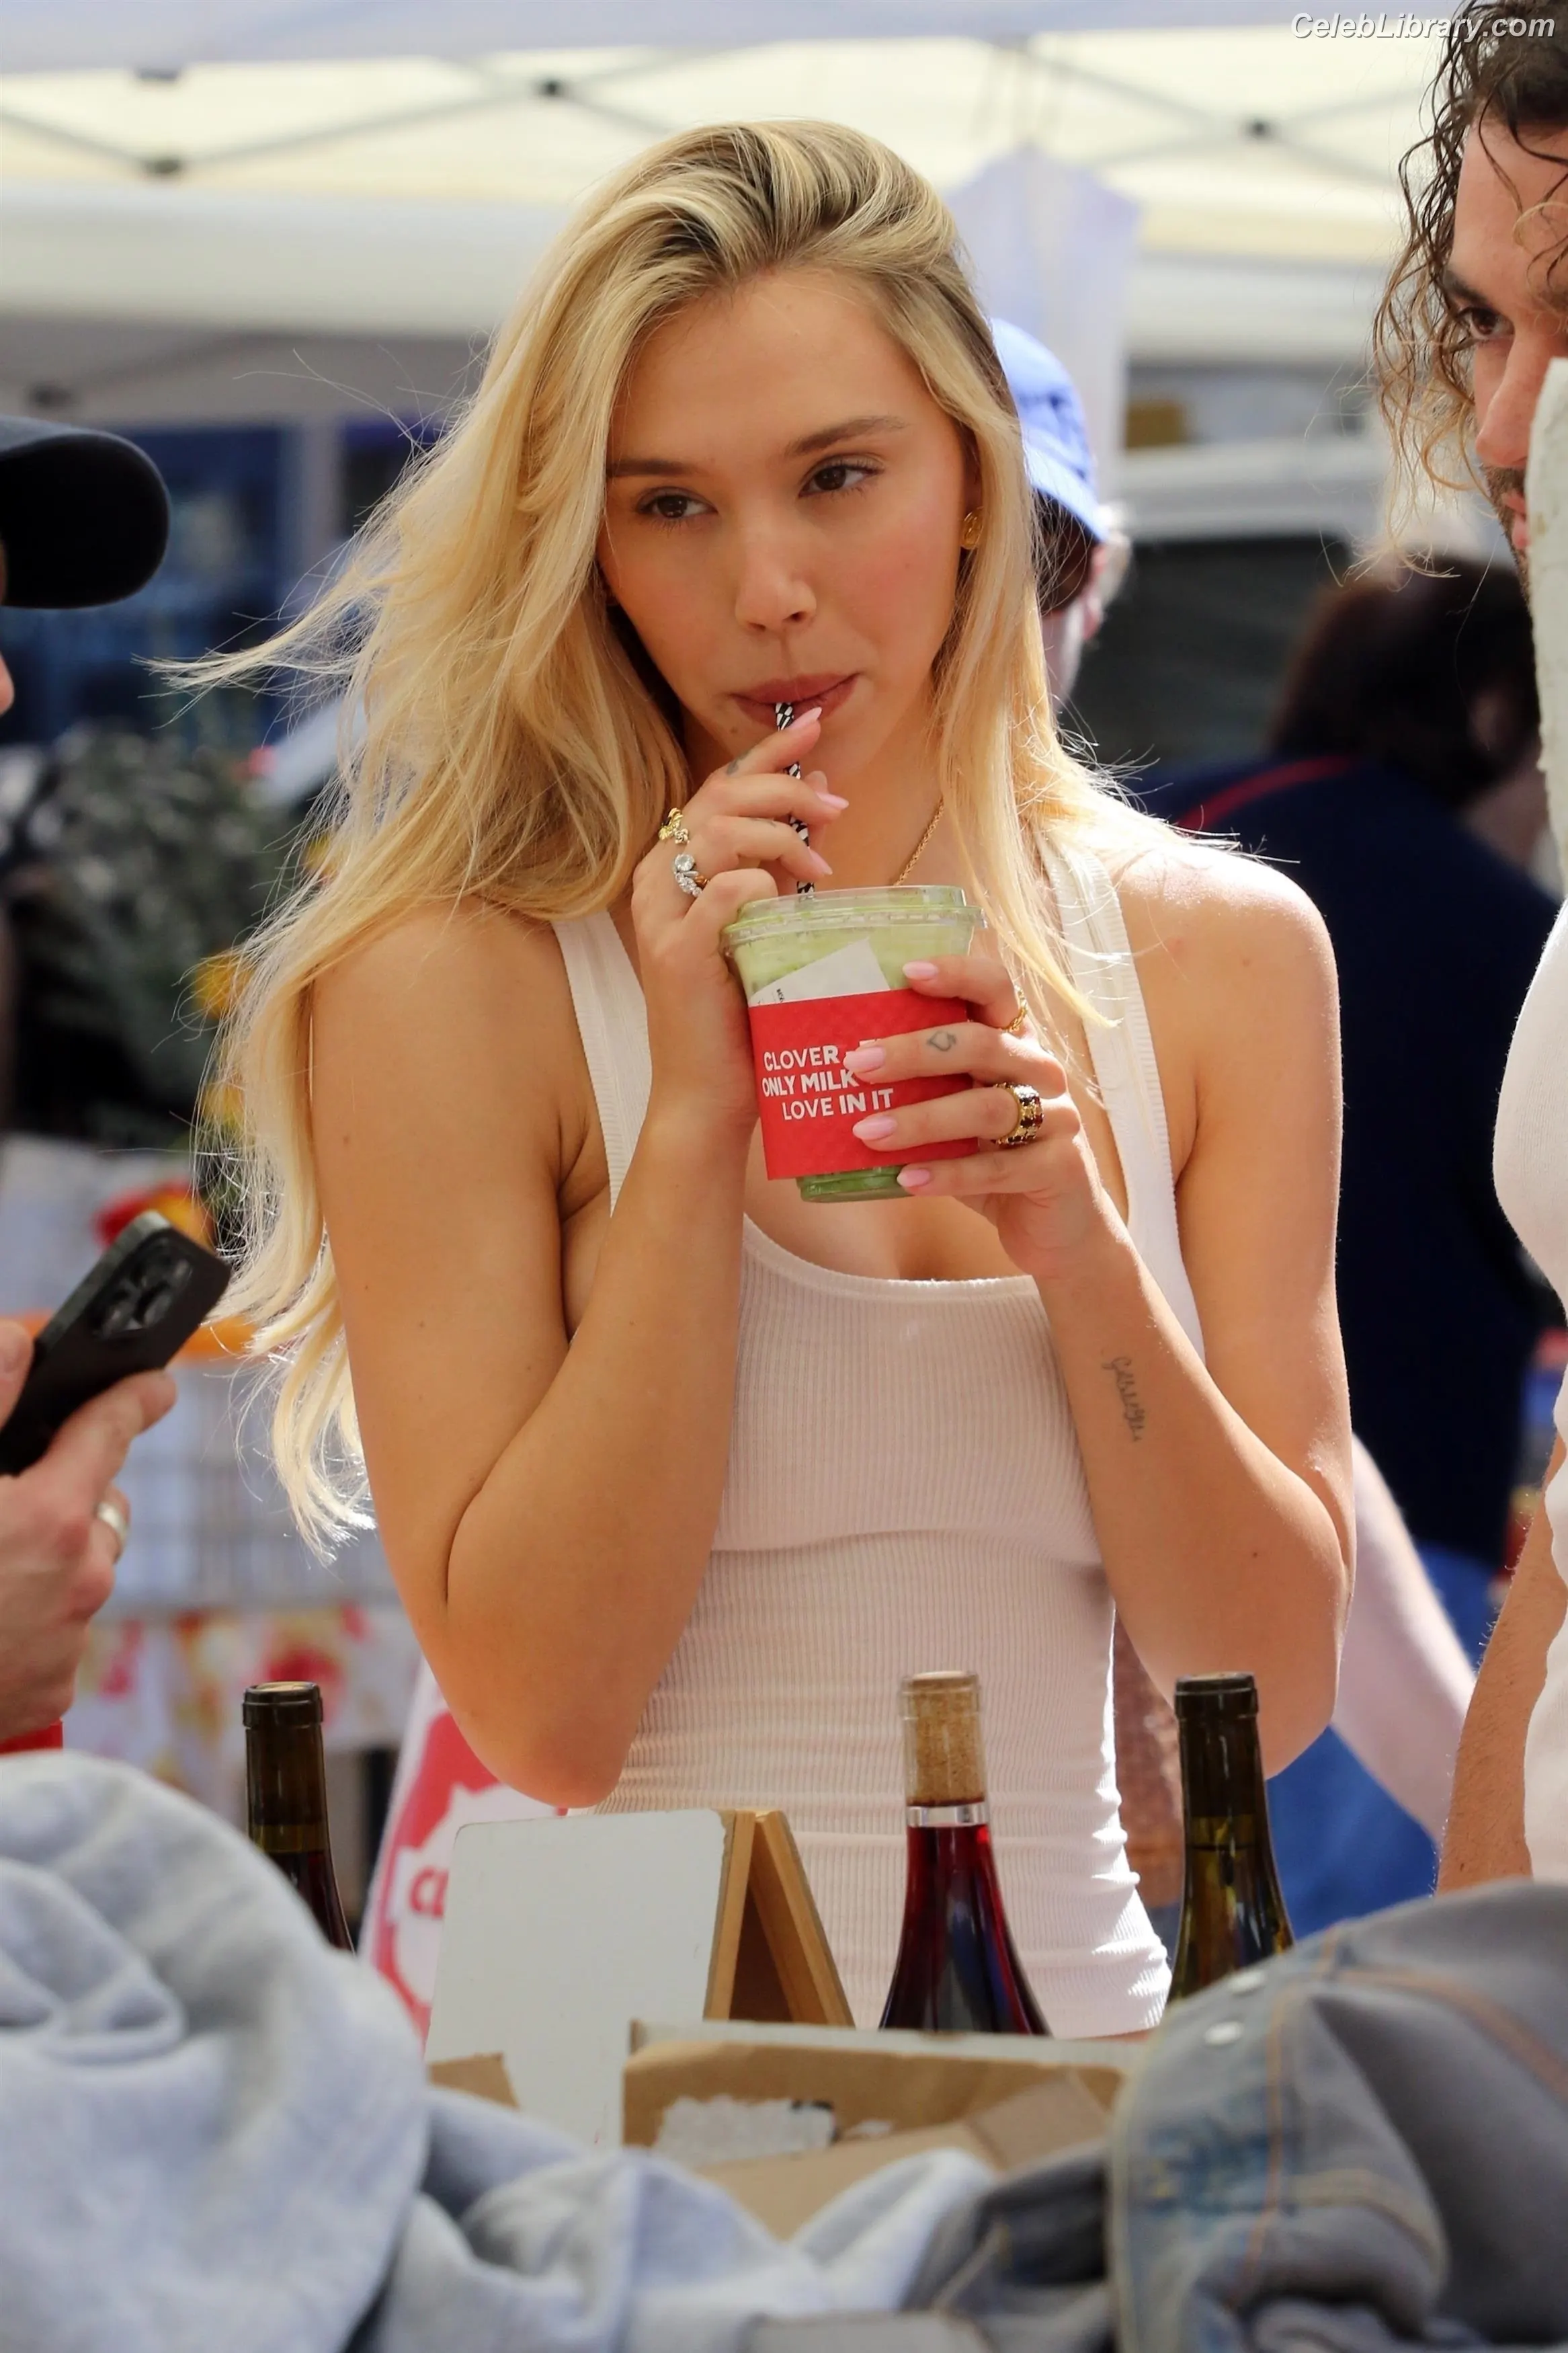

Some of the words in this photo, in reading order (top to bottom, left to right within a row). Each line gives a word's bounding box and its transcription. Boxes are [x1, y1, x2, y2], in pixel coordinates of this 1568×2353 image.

[764, 1045, 840, 1071] CLOVER
[761, 1075, 795, 1097] ONLY
[800, 1069, 860, 1093] MILK
[782, 1097, 834, 1121] LOVE
[839, 1092, 866, 1114] IN
[872, 1088, 894, 1110] IT
